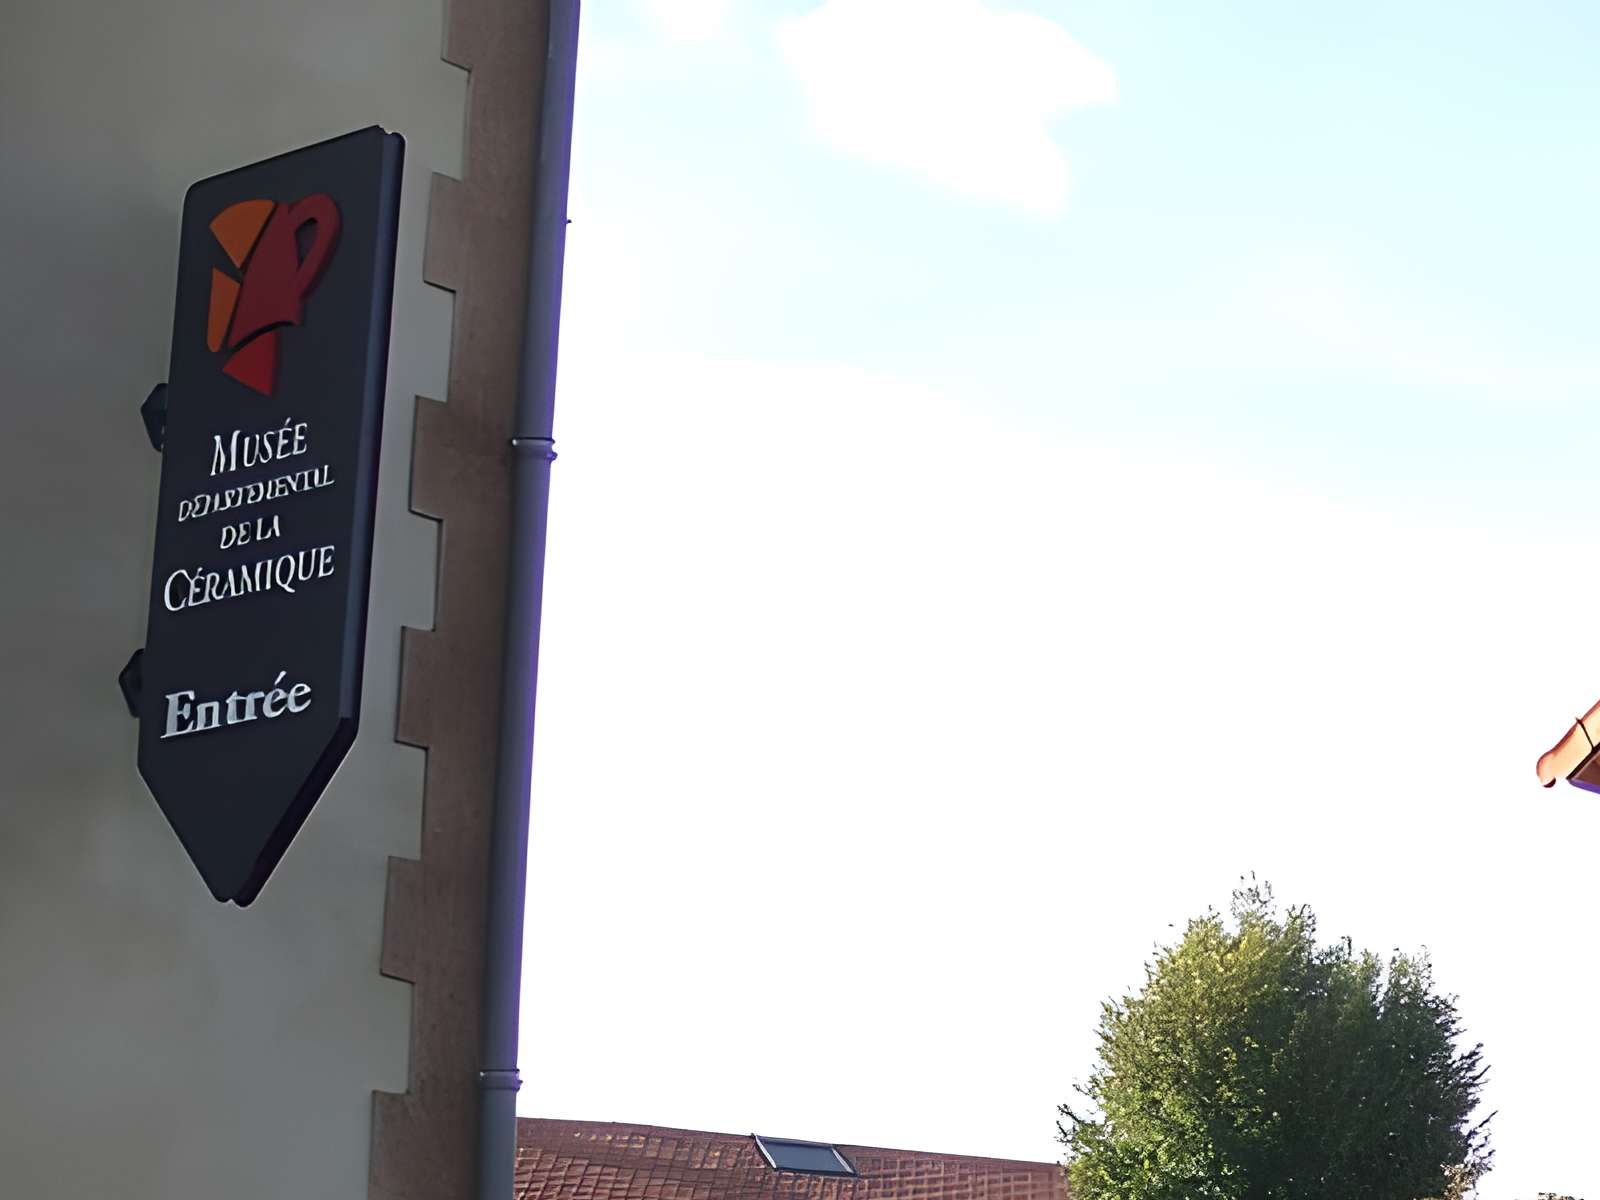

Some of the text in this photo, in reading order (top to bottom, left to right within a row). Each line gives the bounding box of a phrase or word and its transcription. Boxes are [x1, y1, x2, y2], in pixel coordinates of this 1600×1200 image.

[209, 417, 308, 477] MUSÉE
[220, 514, 281, 549] DE LA
[163, 545, 335, 612] CÉRAMIQUE
[160, 670, 312, 739] Entrée
